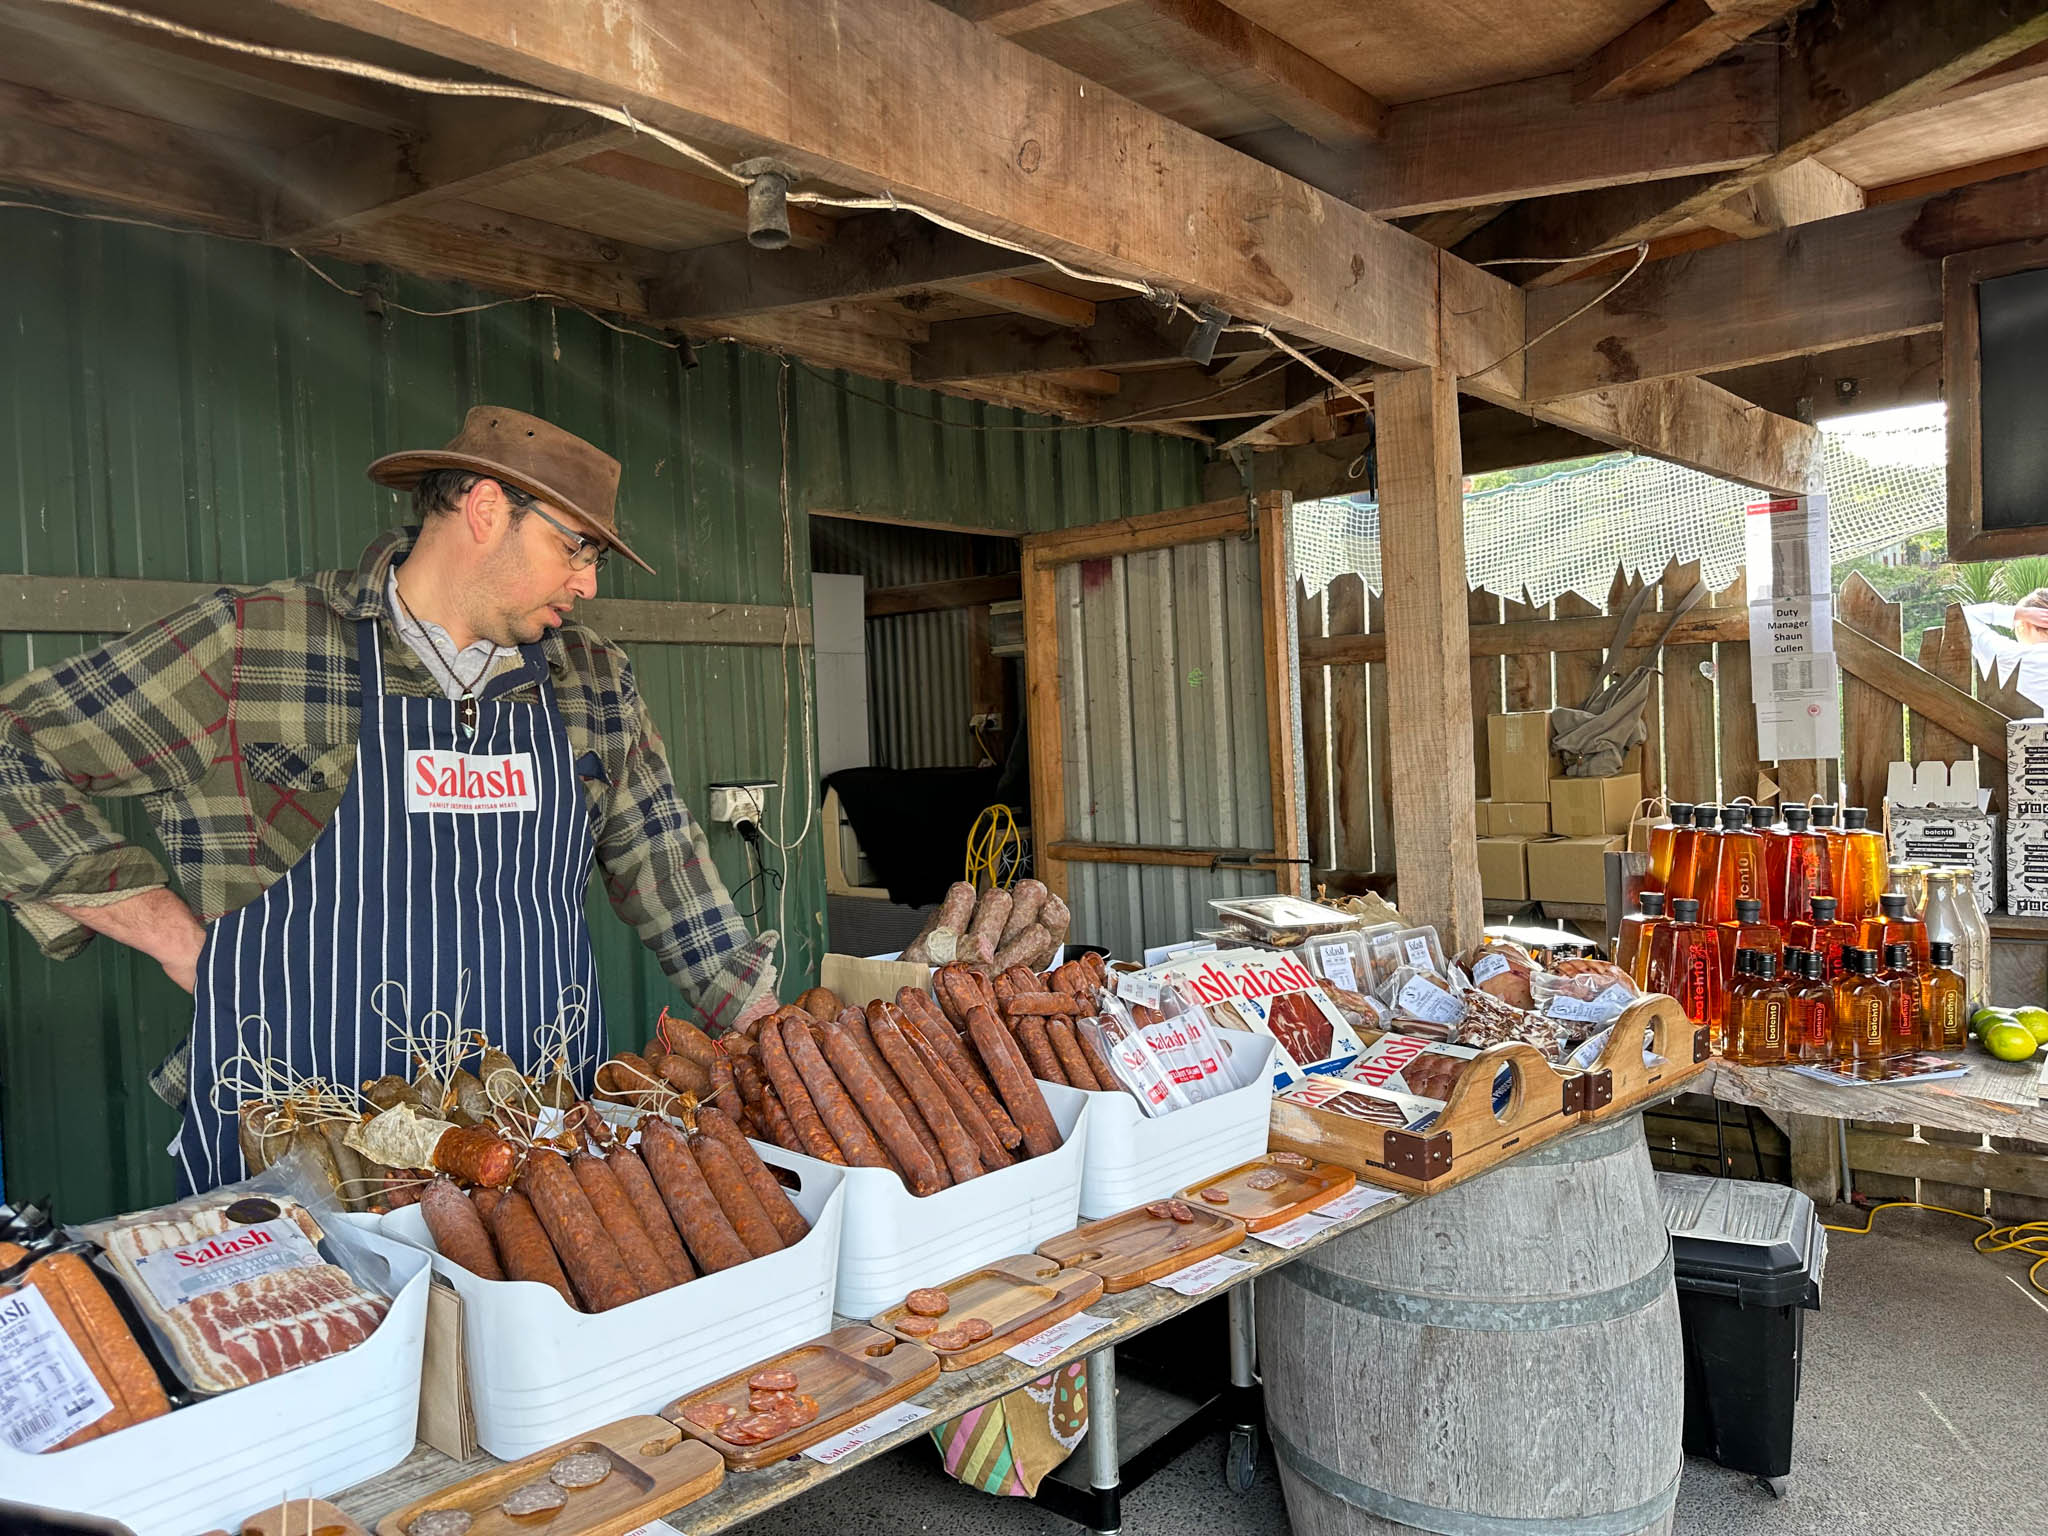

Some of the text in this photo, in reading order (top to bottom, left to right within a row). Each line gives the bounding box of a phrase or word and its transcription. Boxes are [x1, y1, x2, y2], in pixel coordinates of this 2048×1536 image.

[1767, 620, 1809, 630] Manager
[1776, 609, 1799, 618] Duty
[1774, 633, 1803, 642] Shaun
[1774, 645, 1804, 654] Cullen
[415, 755, 528, 799] Salash
[1738, 857, 1750, 898] tch10
[1234, 957, 1318, 1000] alash
[1768, 1005, 1778, 1039] batch10
[1870, 1002, 1879, 1037] batch10
[1947, 993, 1955, 1026] batch10
[1146, 1030, 1188, 1053] Salash
[1354, 1037, 1433, 1087] alash
[174, 1229, 274, 1267] Salash
[1027, 1345, 1064, 1364] Salash
[848, 1424, 873, 1437] HOT
[820, 1438, 864, 1461] Salash
